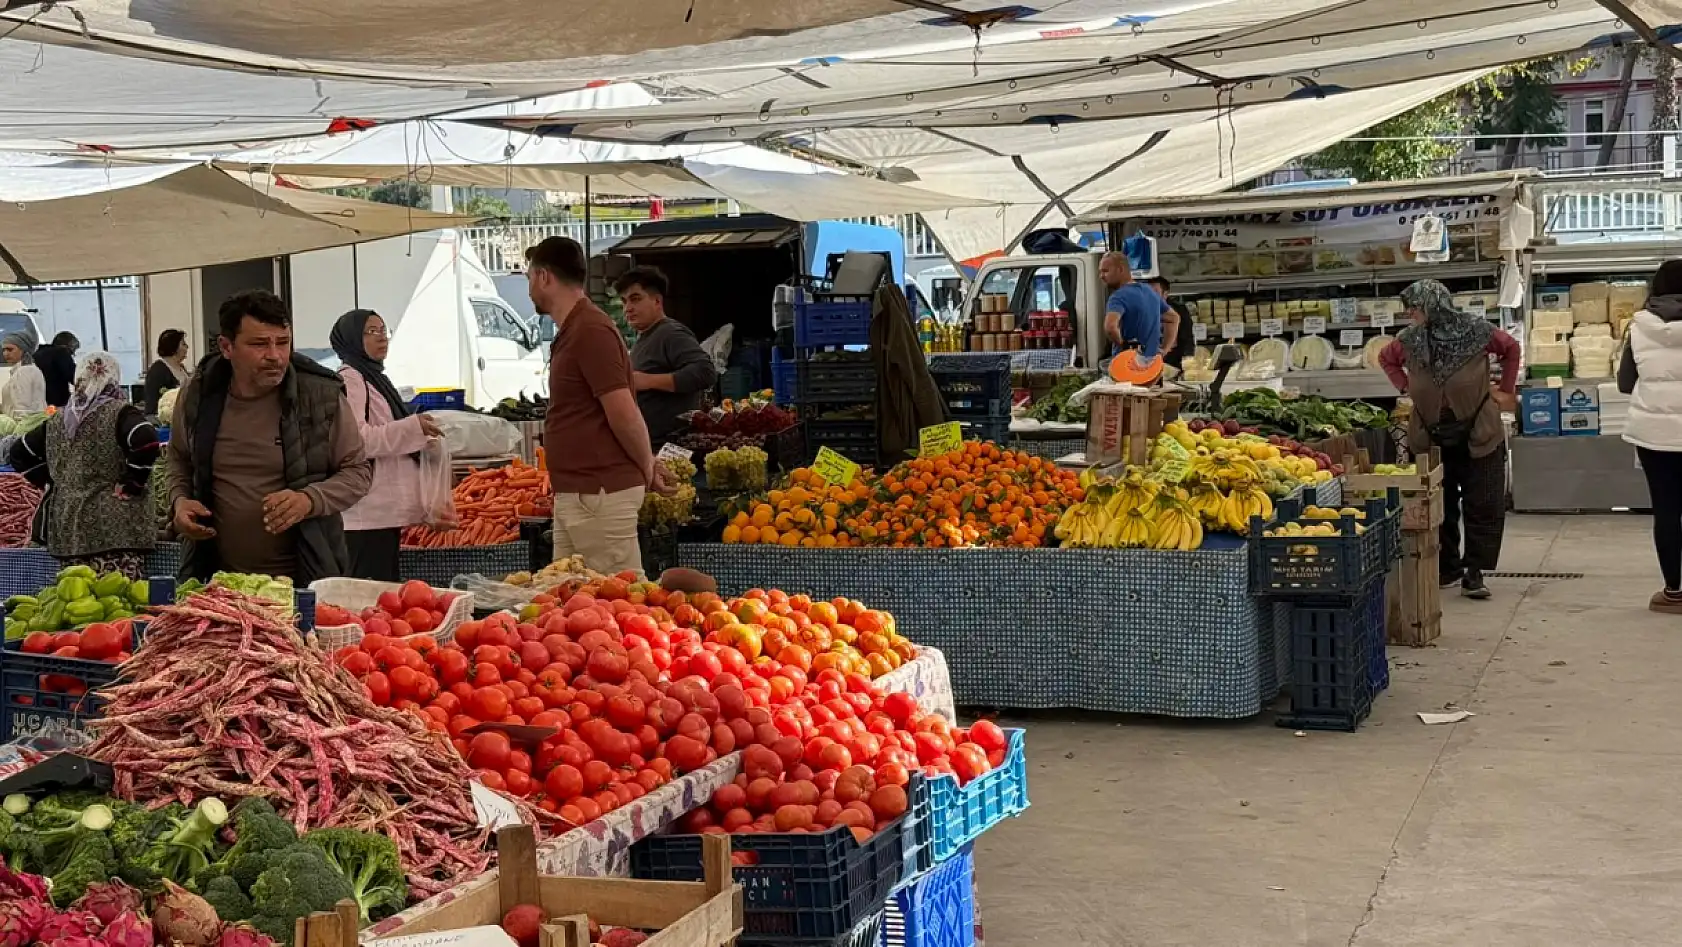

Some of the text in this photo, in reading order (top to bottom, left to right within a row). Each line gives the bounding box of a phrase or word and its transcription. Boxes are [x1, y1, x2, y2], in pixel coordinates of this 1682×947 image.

[1466, 209, 1480, 219] 11
[1484, 206, 1500, 216] 48
[1157, 228, 1178, 238] 537
[1206, 228, 1219, 237] 01
[1224, 228, 1238, 236] 44
